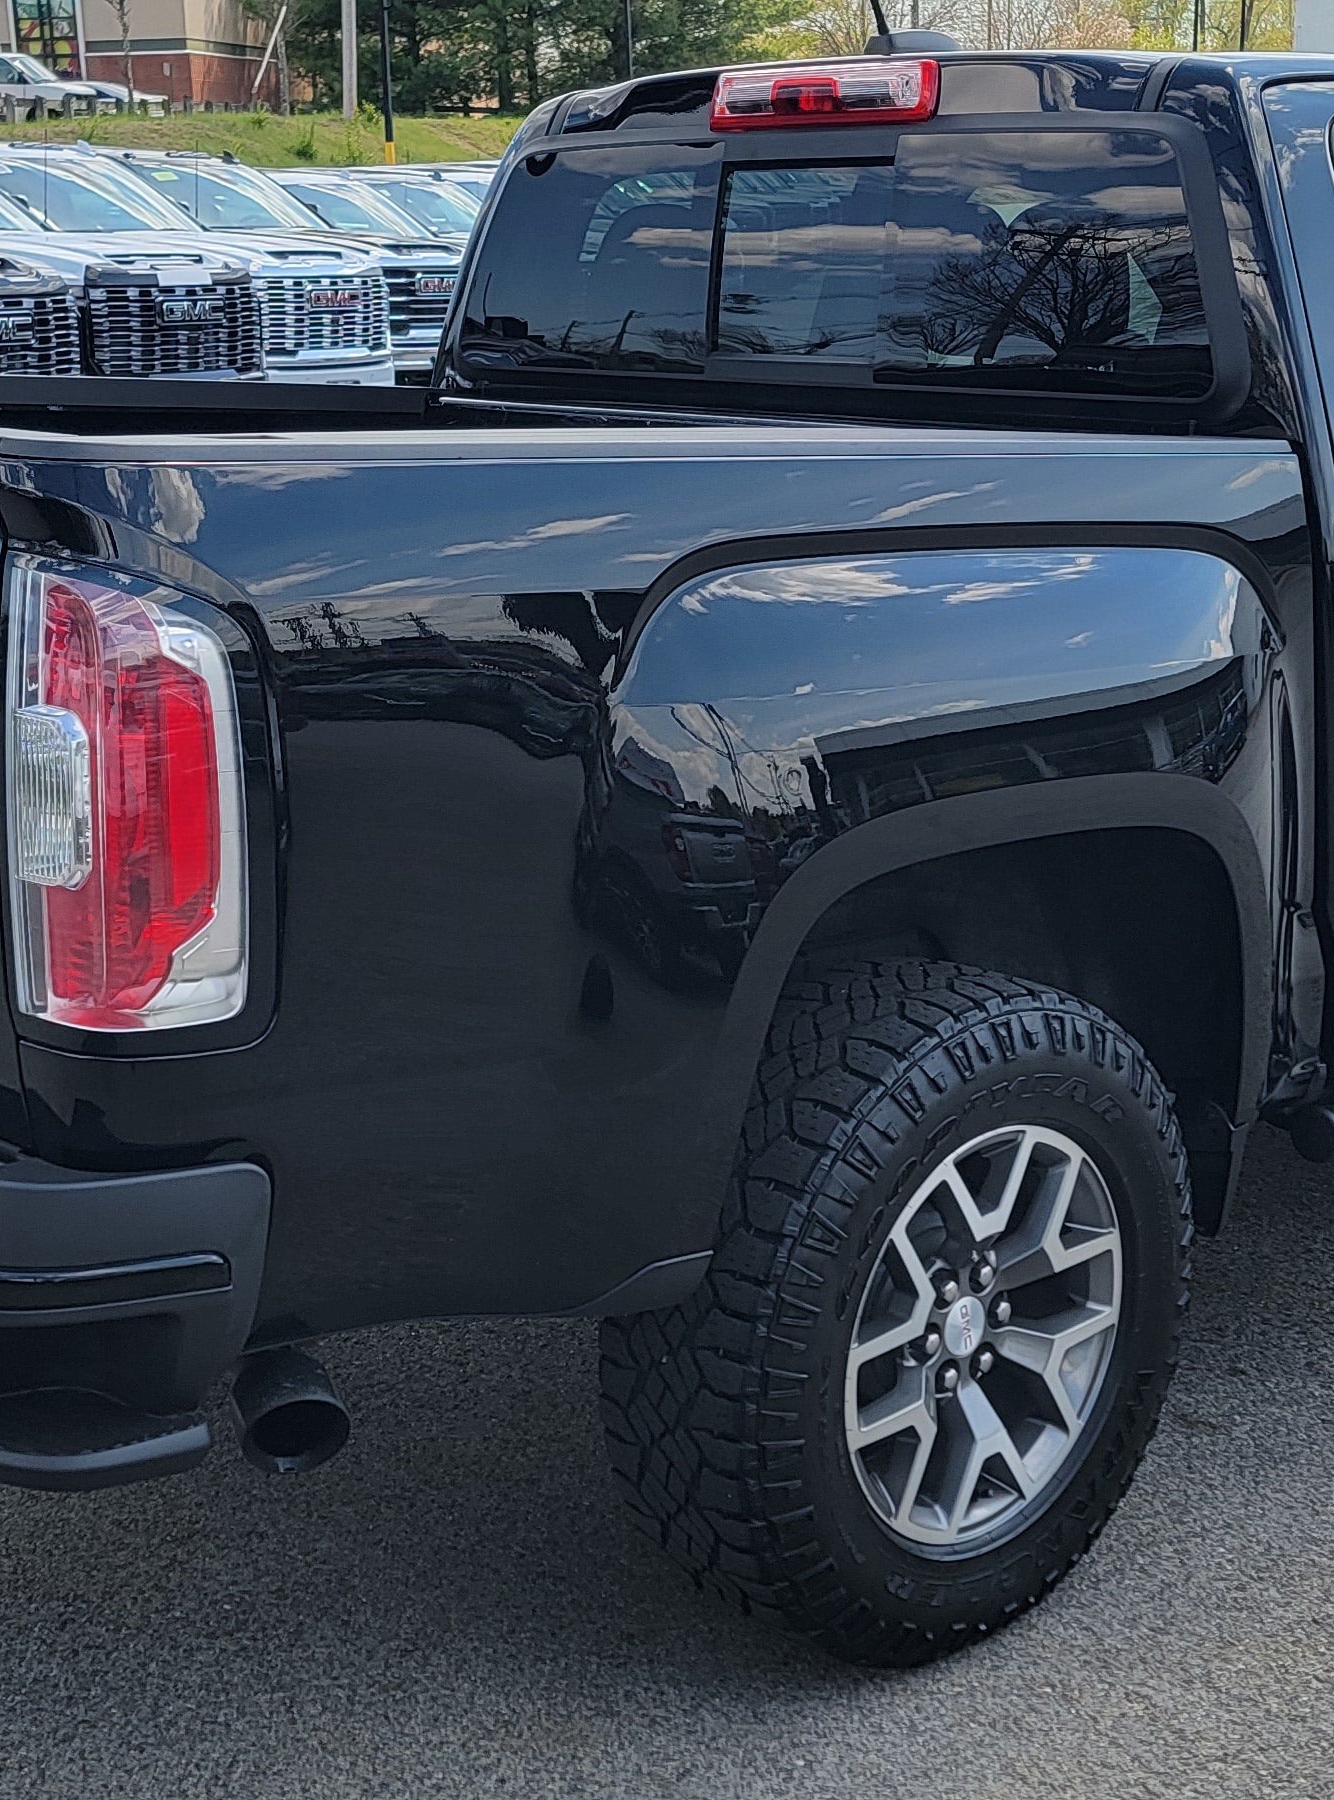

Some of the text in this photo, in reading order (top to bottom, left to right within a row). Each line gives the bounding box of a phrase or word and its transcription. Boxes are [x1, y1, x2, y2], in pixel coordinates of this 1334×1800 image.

[310, 290, 361, 307] GMC
[162, 300, 225, 321] GMC
[959, 1303, 974, 1352] GMC
